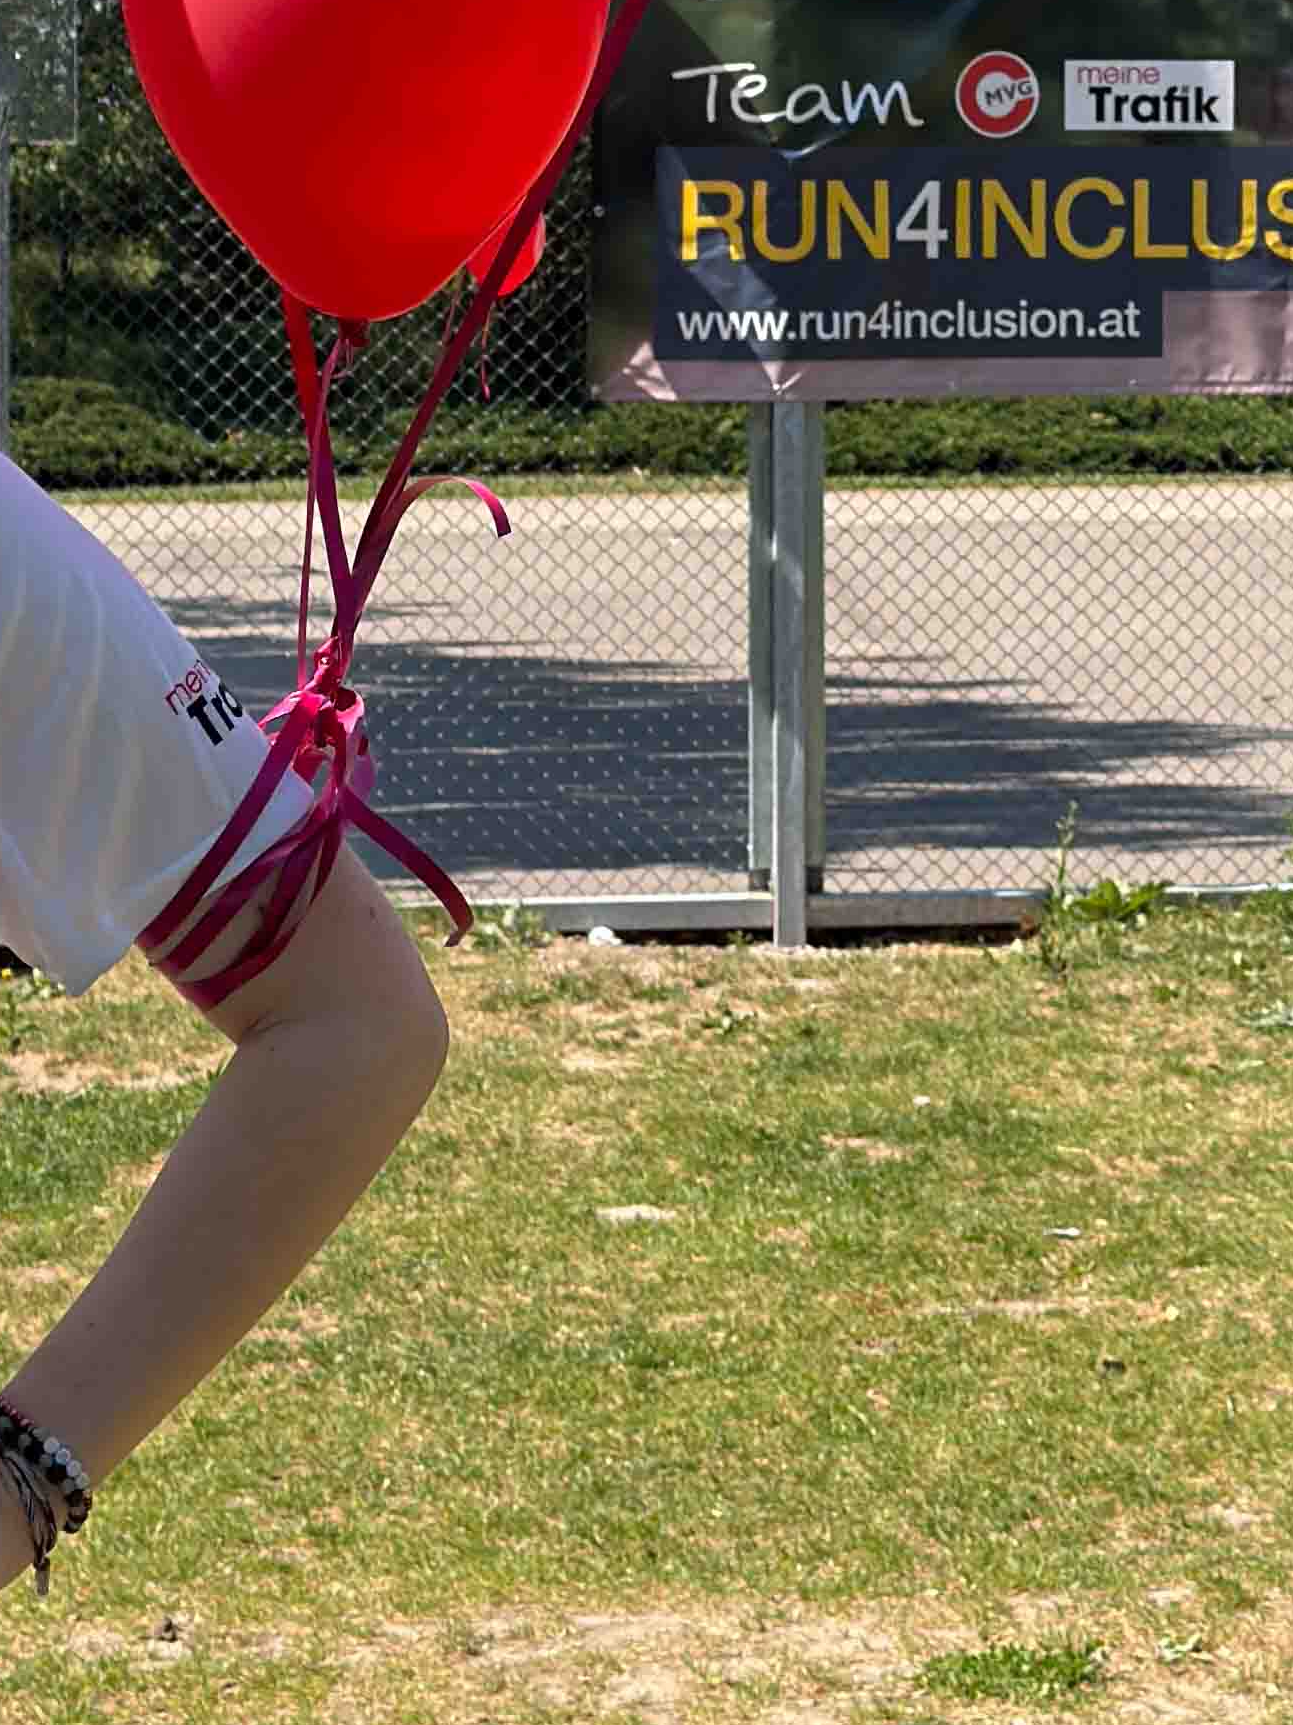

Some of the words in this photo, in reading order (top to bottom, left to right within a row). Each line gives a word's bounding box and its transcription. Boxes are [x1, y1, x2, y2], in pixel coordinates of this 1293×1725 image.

[984, 80, 1033, 106] MVG
[1076, 65, 1160, 85] meine
[671, 63, 925, 127] Team
[1089, 85, 1220, 124] Trafik
[677, 300, 1141, 341] www.run4inclusion.at
